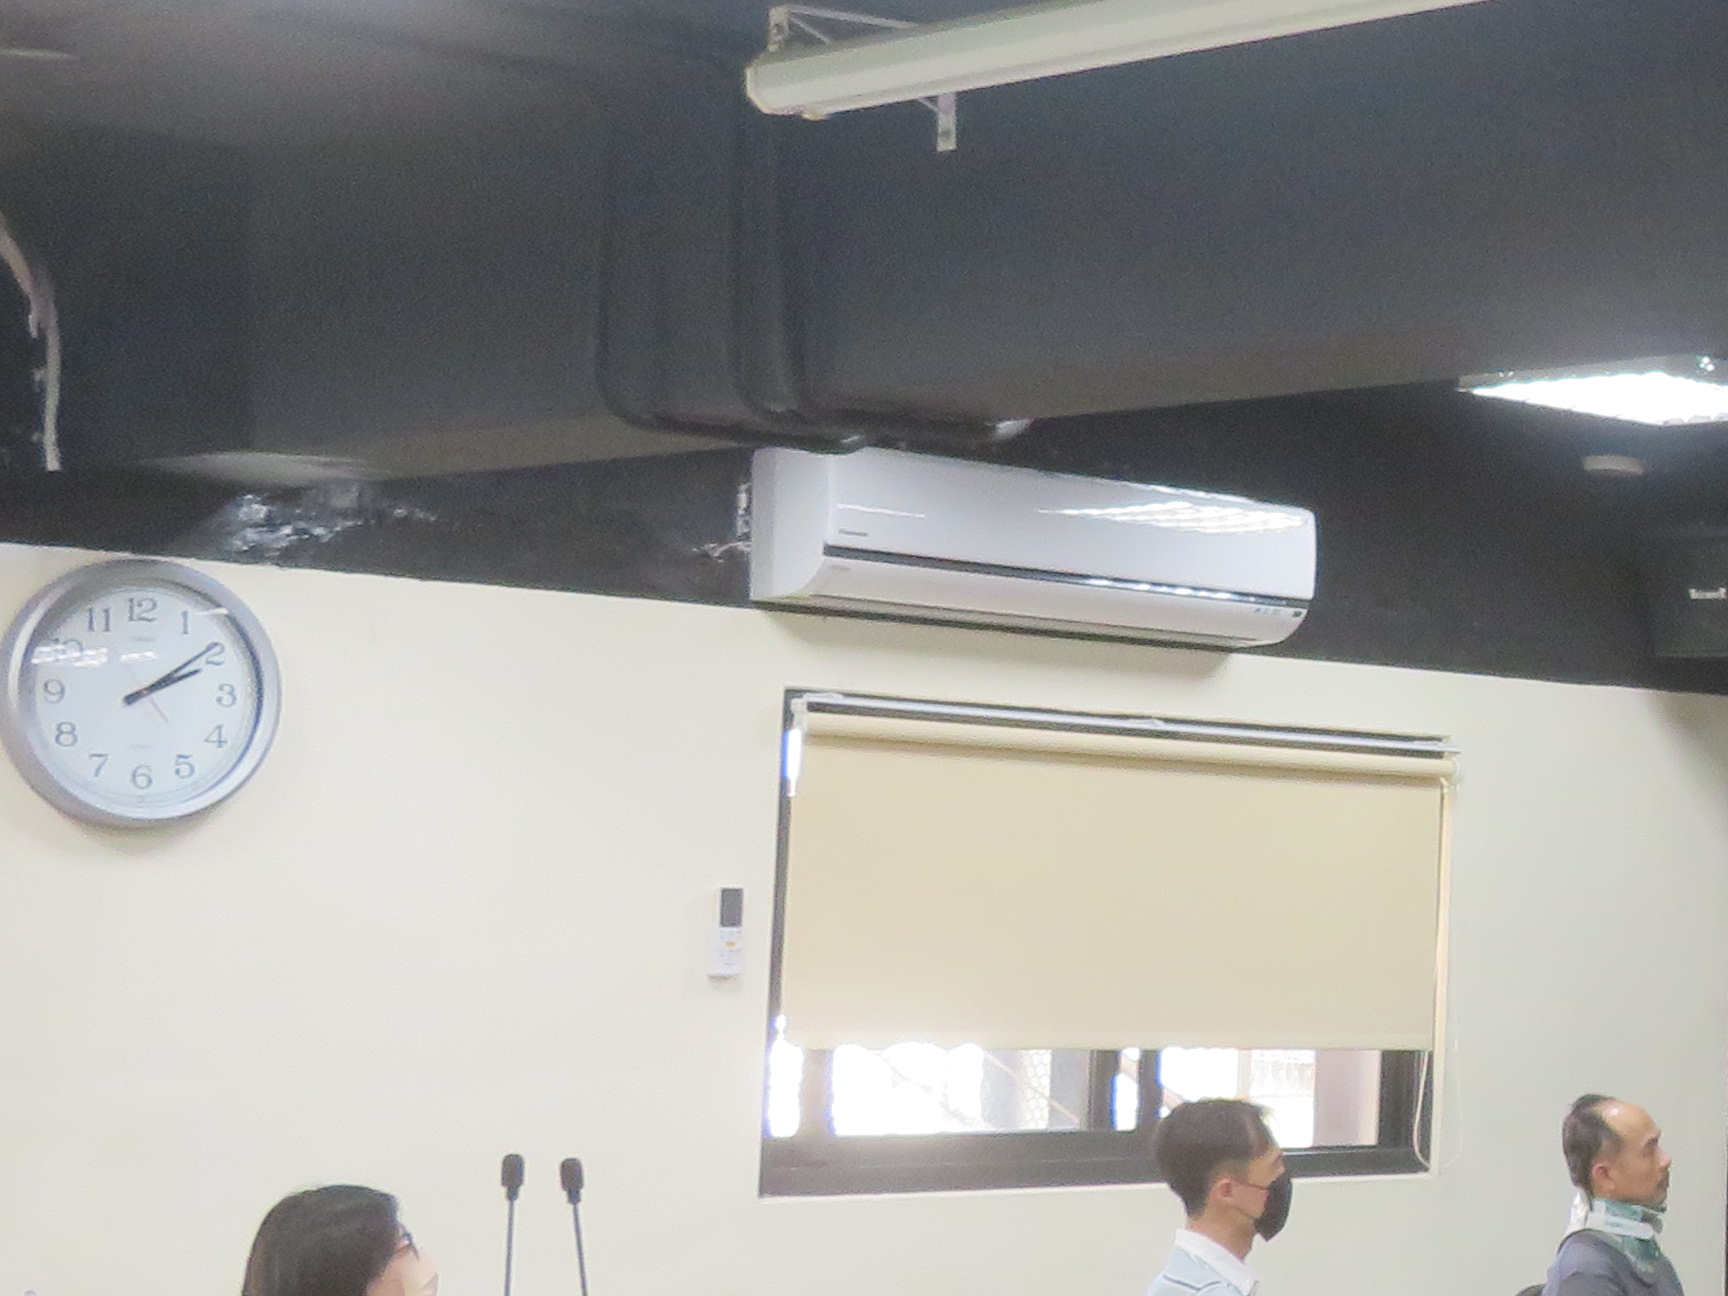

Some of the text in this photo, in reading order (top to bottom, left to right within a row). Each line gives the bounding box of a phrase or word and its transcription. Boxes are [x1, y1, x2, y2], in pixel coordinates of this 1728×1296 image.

[86, 606, 112, 633] 11
[127, 597, 158, 623] 12
[180, 610, 190, 635] 1
[204, 641, 226, 666] 2
[43, 678, 66, 704] 9
[215, 683, 238, 708] 3
[54, 721, 79, 747] 8
[203, 724, 228, 749] 4
[88, 753, 109, 778] 7
[131, 764, 153, 790] 6
[174, 754, 196, 779] 5
